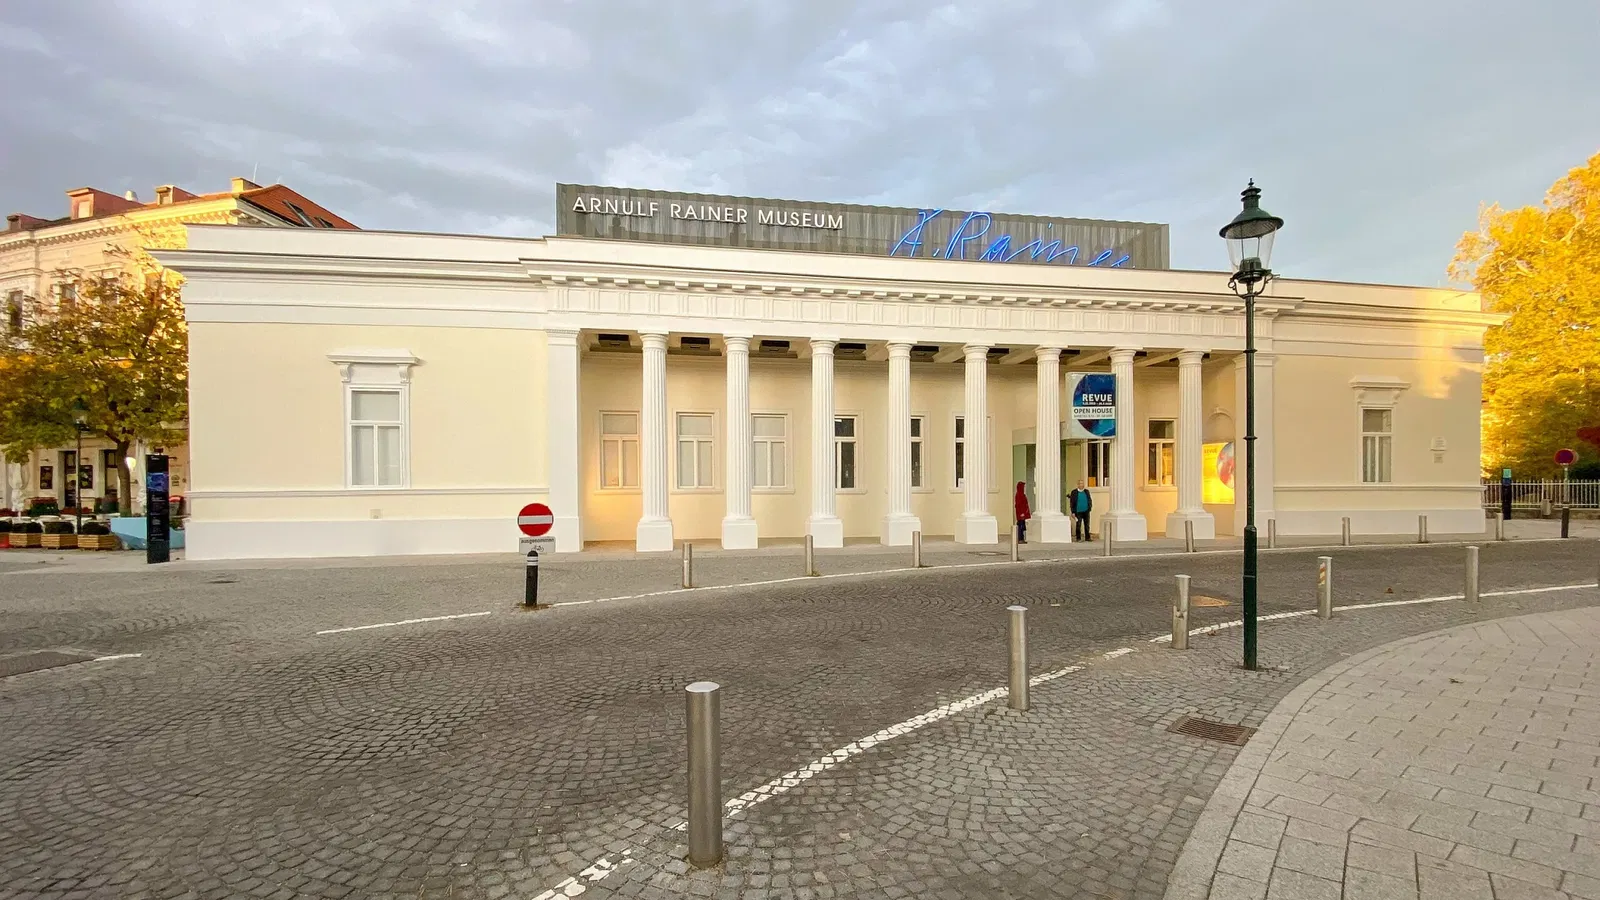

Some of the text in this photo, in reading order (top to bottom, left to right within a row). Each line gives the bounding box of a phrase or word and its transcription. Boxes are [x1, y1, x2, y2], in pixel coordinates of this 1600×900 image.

[573, 196, 844, 229] ARNULF RAINER MUSEUM
